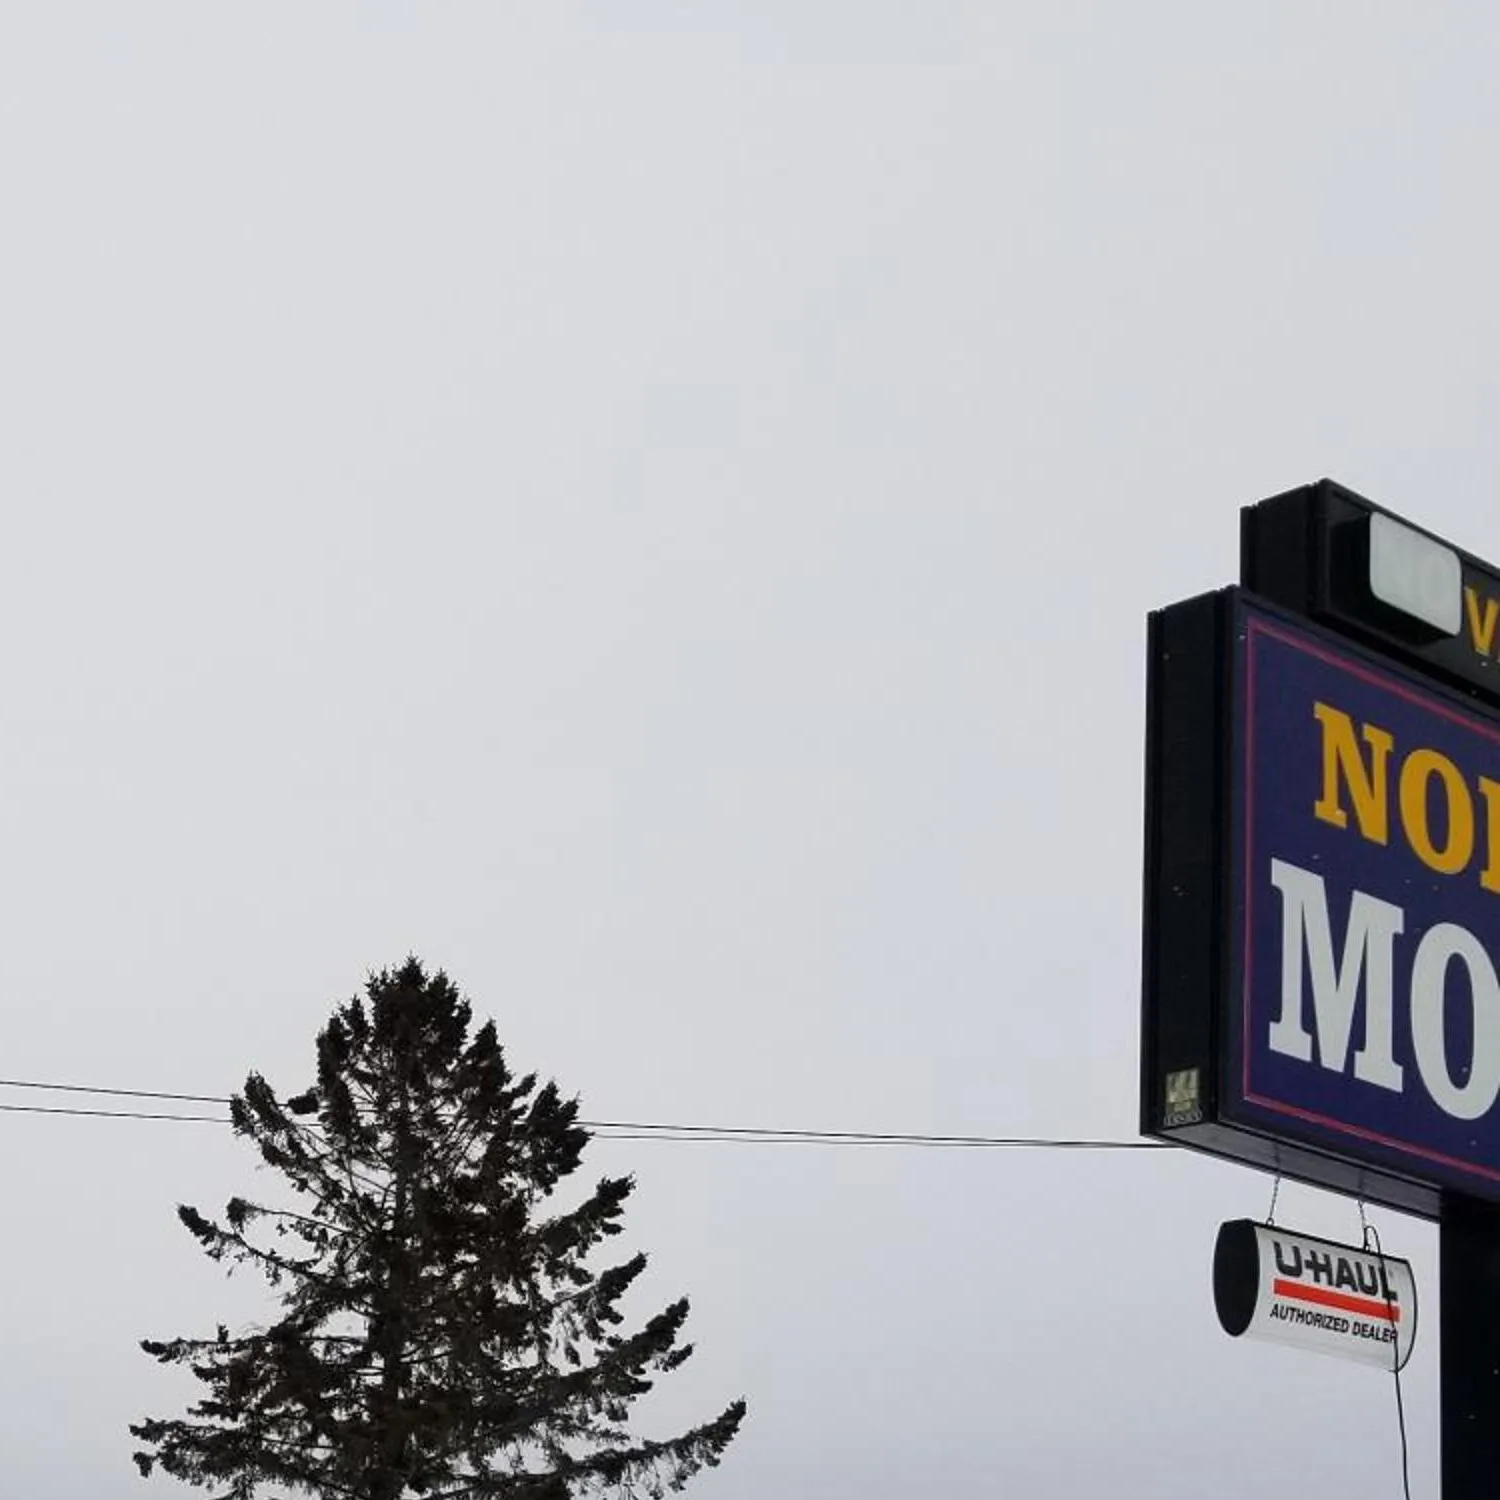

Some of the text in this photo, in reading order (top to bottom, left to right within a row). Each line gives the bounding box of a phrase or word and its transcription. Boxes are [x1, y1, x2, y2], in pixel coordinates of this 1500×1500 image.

[1313, 701, 1500, 896] NO
[1273, 1241, 1398, 1301] U-HAUL
[1269, 1303, 1398, 1343] AUTHORIZED DEALER
